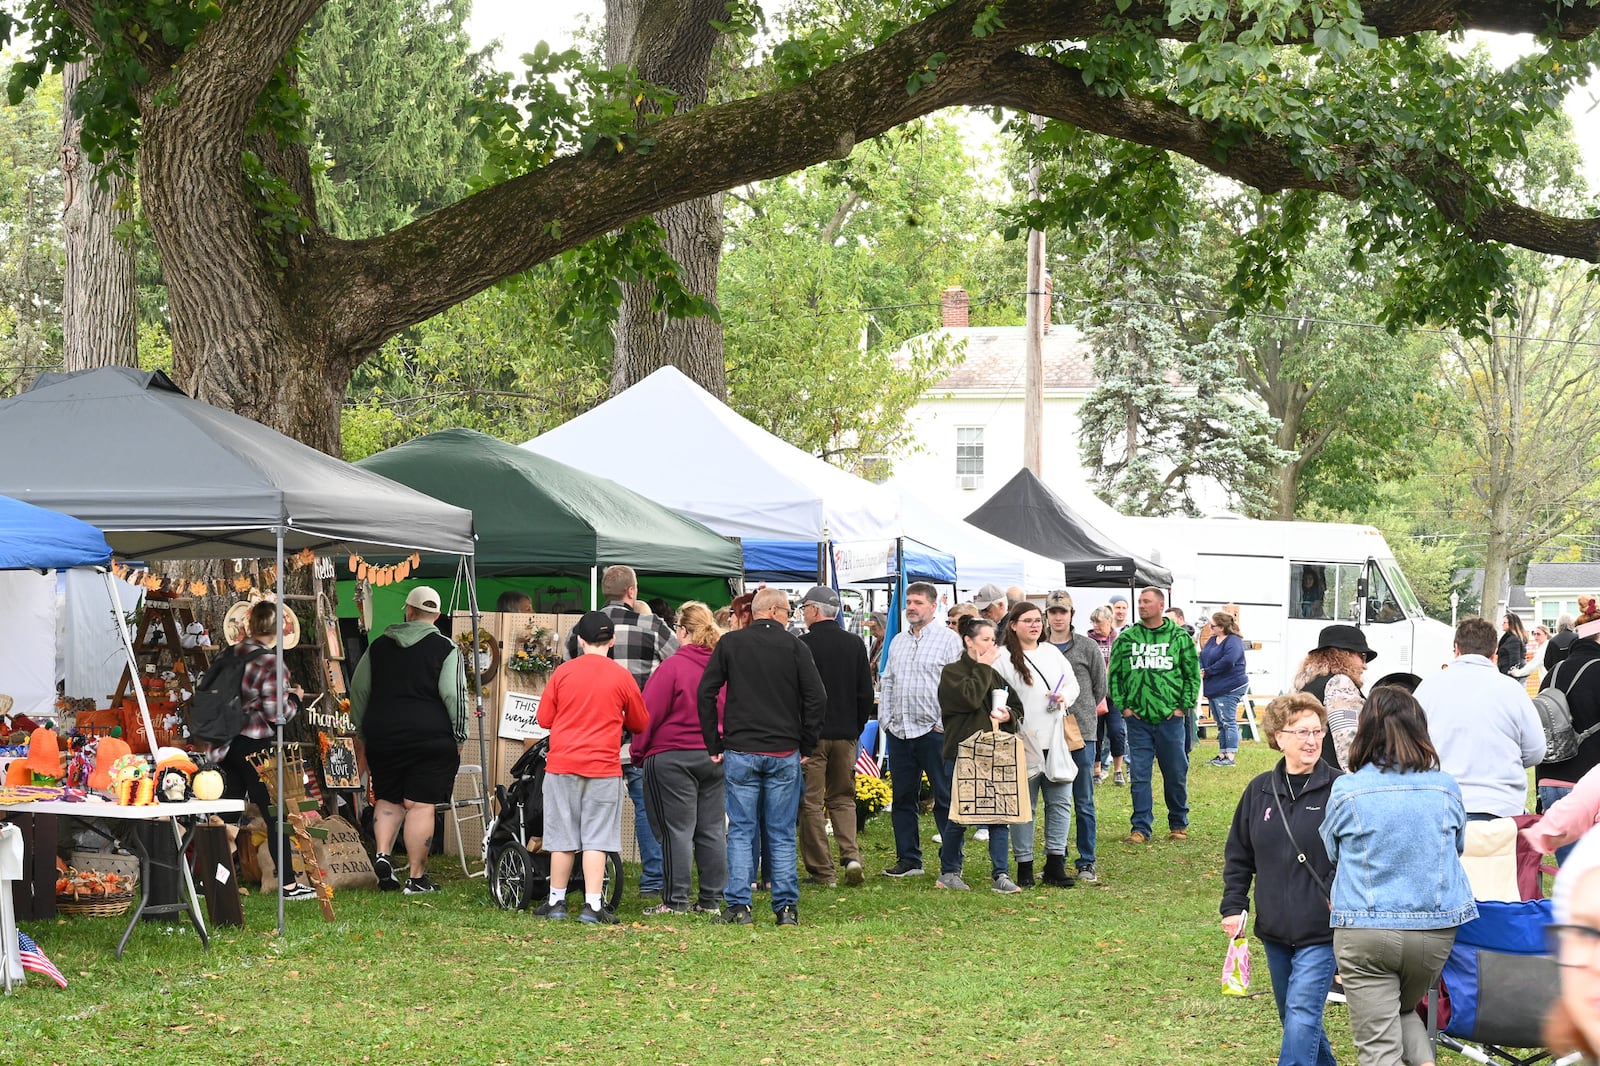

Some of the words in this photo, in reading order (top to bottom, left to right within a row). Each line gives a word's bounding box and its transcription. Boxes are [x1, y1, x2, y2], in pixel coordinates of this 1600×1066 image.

[314, 556, 335, 580] hello
[1131, 642, 1170, 656] LOST
[1129, 655, 1174, 670] LANDS
[515, 700, 537, 713] THIS
[305, 706, 357, 734] Thankfu
[330, 763, 350, 776] LOVE
[322, 831, 361, 845] ARM
[330, 861, 372, 874] FARM
